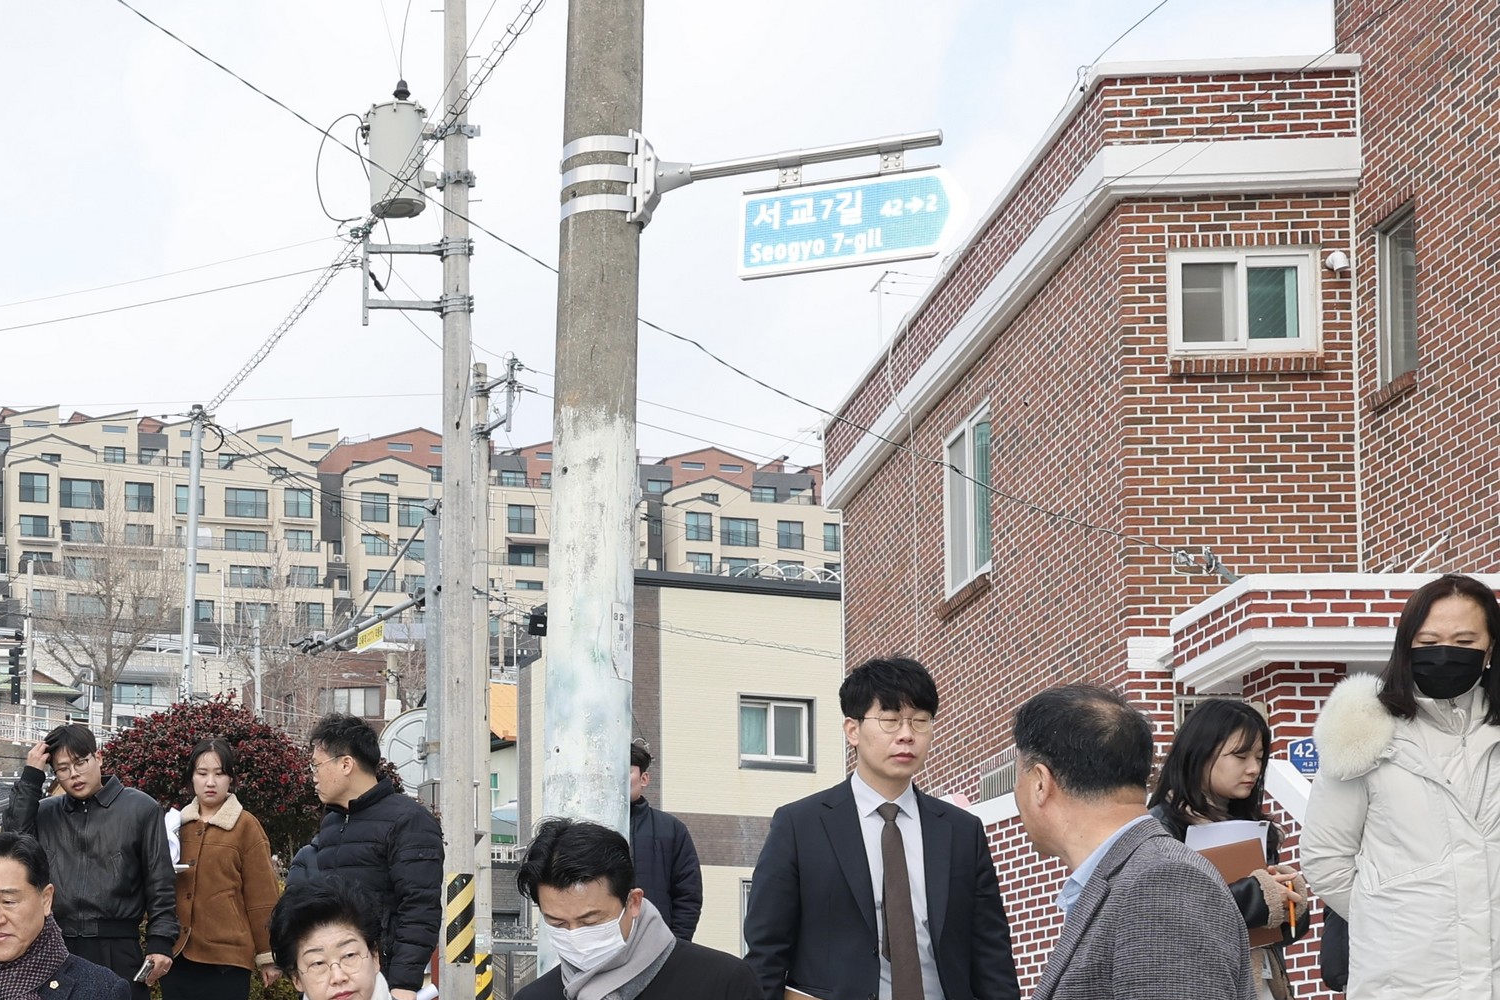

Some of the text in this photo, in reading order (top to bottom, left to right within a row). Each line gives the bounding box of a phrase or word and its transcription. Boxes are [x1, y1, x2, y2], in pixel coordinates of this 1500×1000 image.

[753, 189, 863, 230] 서교7길
[880, 199, 903, 218] 42
[750, 227, 883, 263] Seogyo 7-gil
